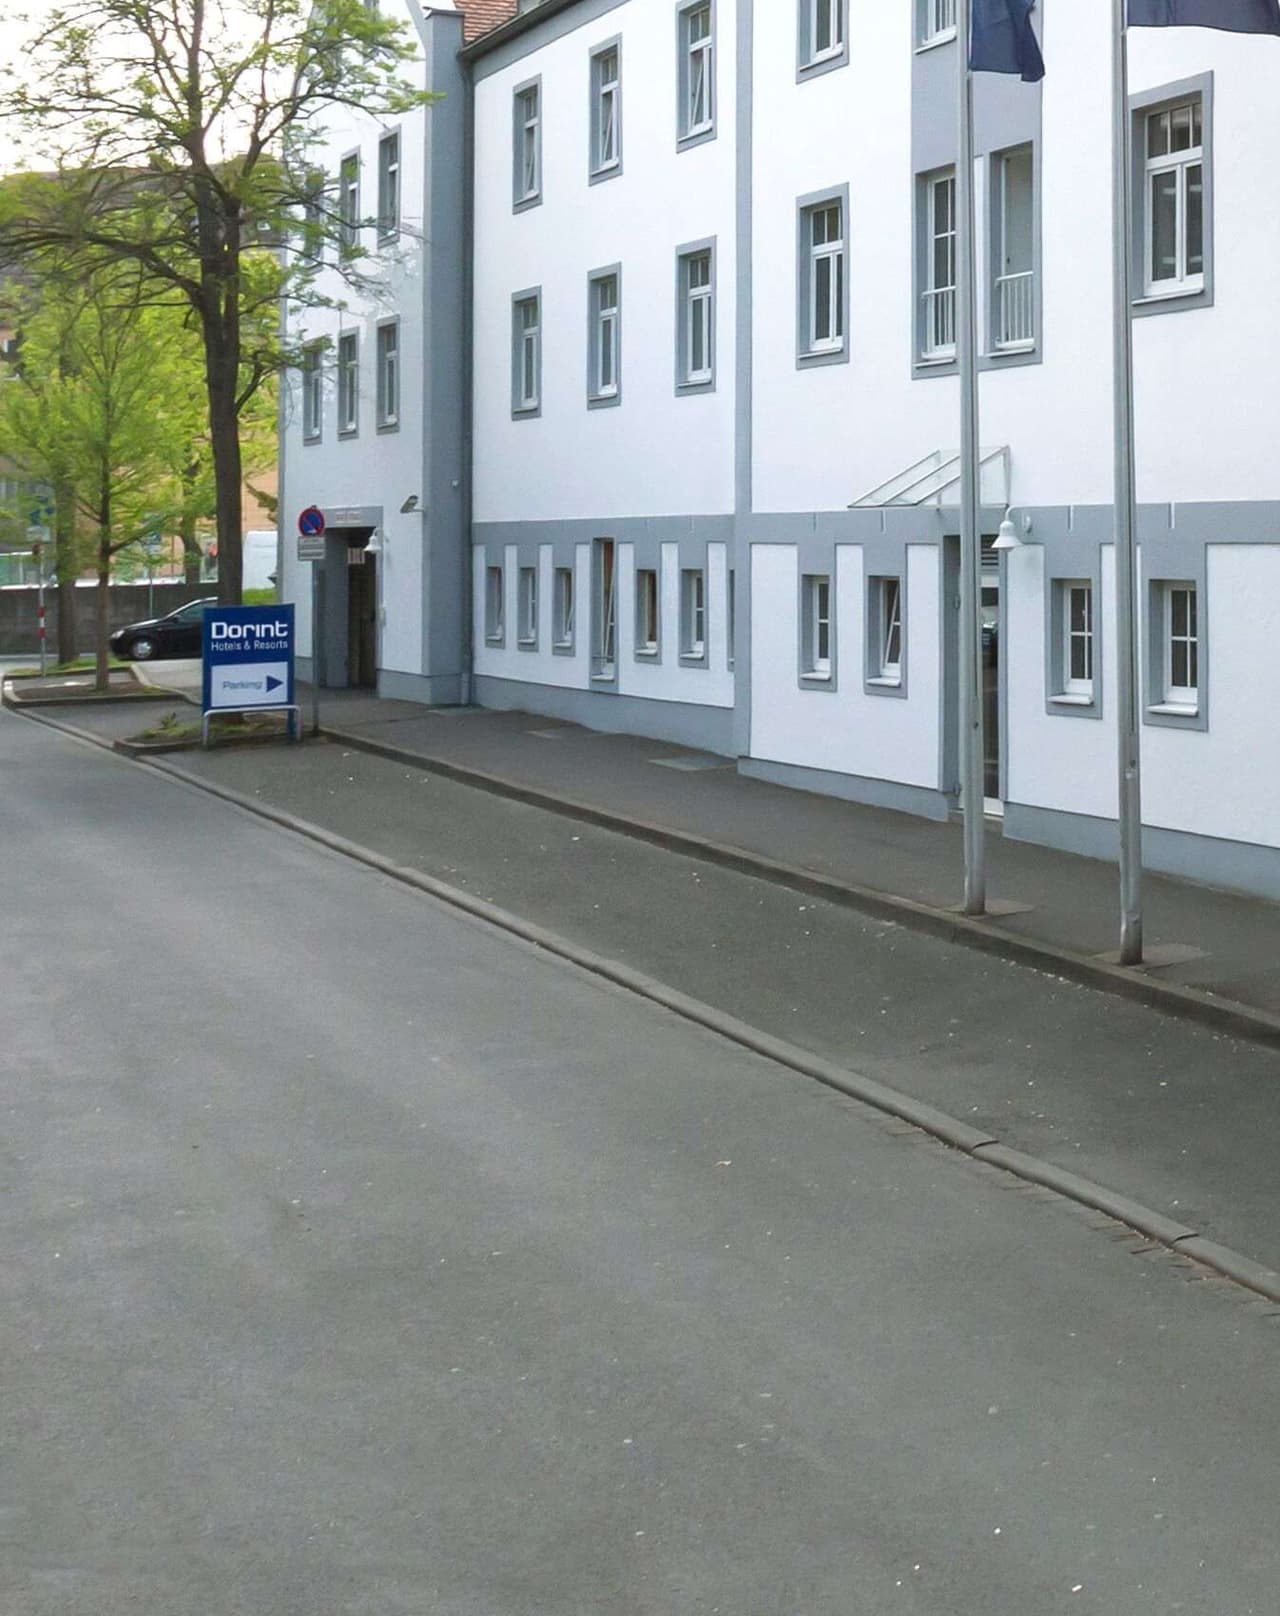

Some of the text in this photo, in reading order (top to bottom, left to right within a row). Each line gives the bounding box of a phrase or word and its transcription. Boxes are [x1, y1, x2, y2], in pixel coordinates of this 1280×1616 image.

[211, 621, 288, 639] Dorint
[211, 640, 288, 651] Hotels & Resorts
